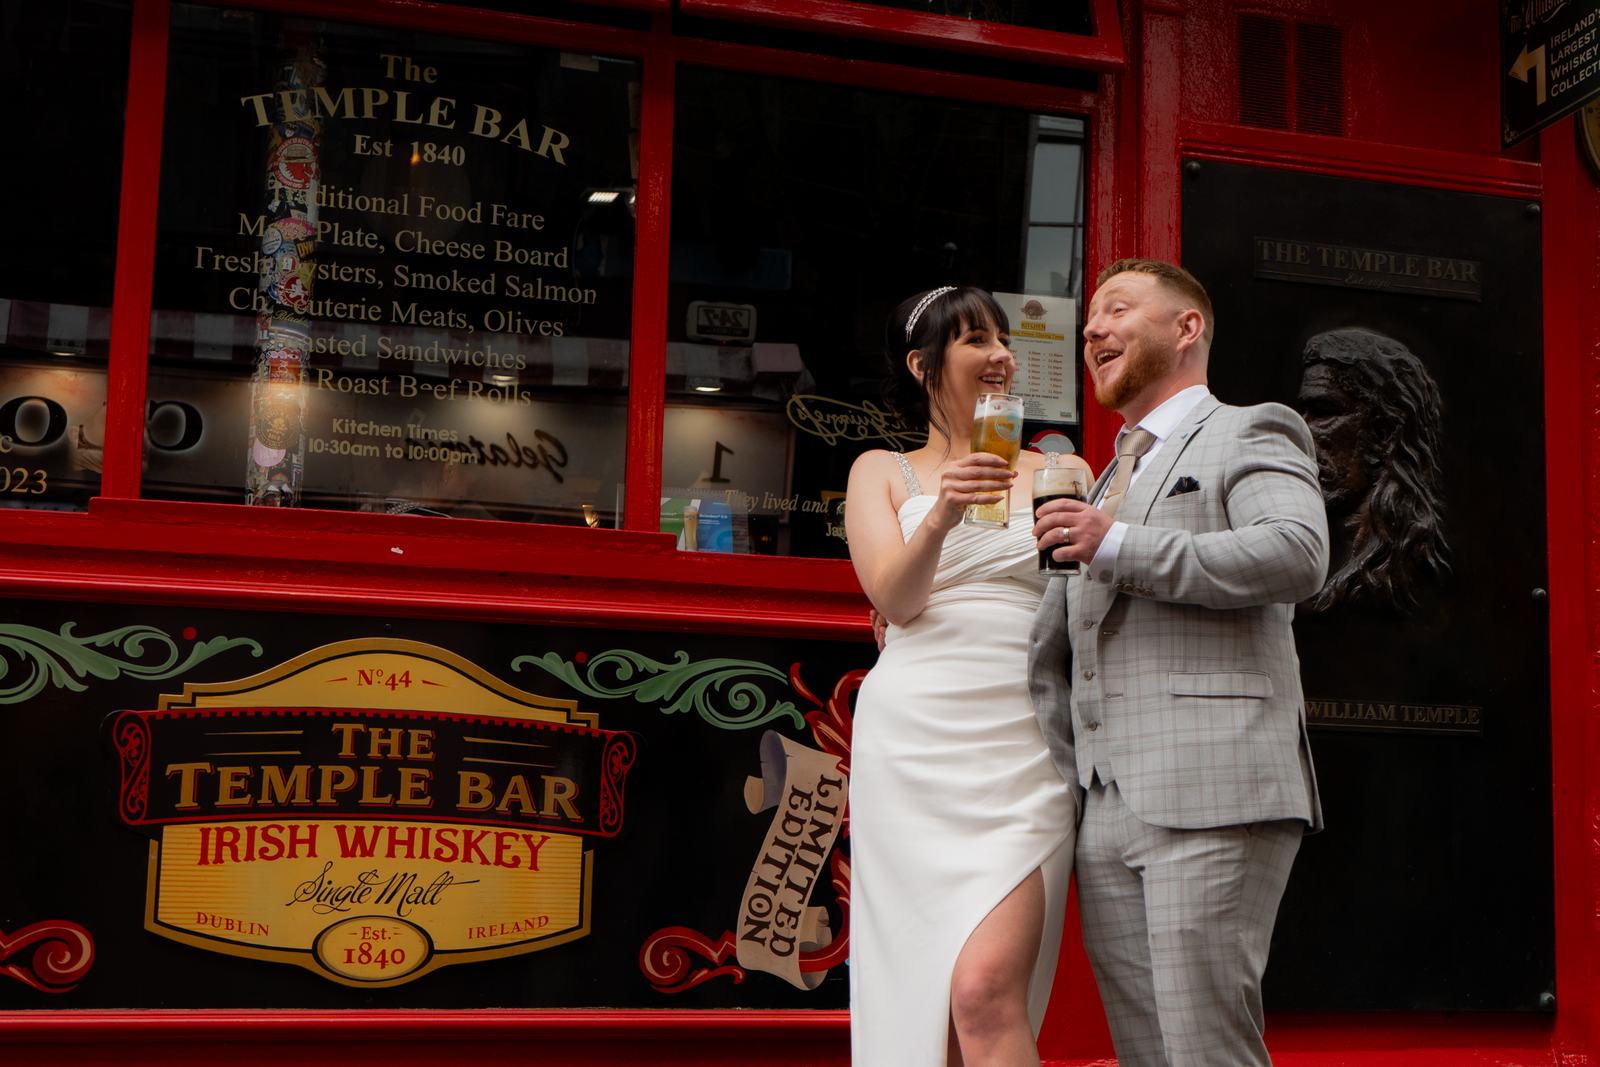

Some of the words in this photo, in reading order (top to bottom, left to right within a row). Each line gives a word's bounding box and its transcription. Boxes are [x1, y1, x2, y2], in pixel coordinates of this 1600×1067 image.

[1550, 28, 1597, 65] LARGEST
[1550, 43, 1599, 81] WHISKEY
[380, 53, 438, 84] The
[241, 86, 456, 129] TEMPLE
[469, 103, 570, 166] BAR
[353, 134, 393, 158] Est
[410, 141, 466, 167] 1840
[418, 195, 483, 224] Food
[489, 204, 545, 231] Fare
[315, 220, 386, 254] Plate,
[394, 229, 486, 259] Cheese
[494, 240, 569, 269] Board
[1256, 239, 1311, 265] THE
[1316, 246, 1420, 277] TEMPLE
[1426, 258, 1479, 283] BAR
[298, 258, 384, 287] ysters,
[393, 264, 497, 296] Smoked
[505, 274, 597, 305] Salmon
[228, 287, 382, 320] Chcuterie
[391, 300, 475, 334] Meats,
[483, 309, 564, 337] Olives
[290, 335, 368, 358] asted
[377, 336, 527, 370] Sandwiches
[317, 368, 391, 396] Roast
[400, 374, 460, 400] Beef
[466, 380, 531, 406] Rolls
[332, 418, 401, 437] Kitchen
[407, 424, 458, 443] Times
[308, 438, 380, 458] 10:30am
[386, 444, 404, 460] to
[408, 445, 478, 465] 10:00pm
[725, 489, 760, 513] They
[762, 491, 800, 512] lived
[801, 496, 830, 514] and
[1305, 702, 1398, 722] WILLIAM
[1401, 705, 1481, 725] TEMPLE
[331, 721, 437, 763] THE
[165, 761, 435, 812] TEMPLE
[456, 769, 584, 823] BAR
[197, 824, 320, 866] IRISH
[335, 824, 551, 872] WHISKEY
[741, 785, 814, 946] EDITION
[769, 773, 842, 958] LIMITED
[286, 860, 379, 915] Single
[374, 870, 480, 917] Malt
[195, 912, 270, 937] DUBLIN
[361, 926, 392, 941] Est.
[468, 914, 550, 940] IRELAND
[343, 942, 406, 970] 1840
